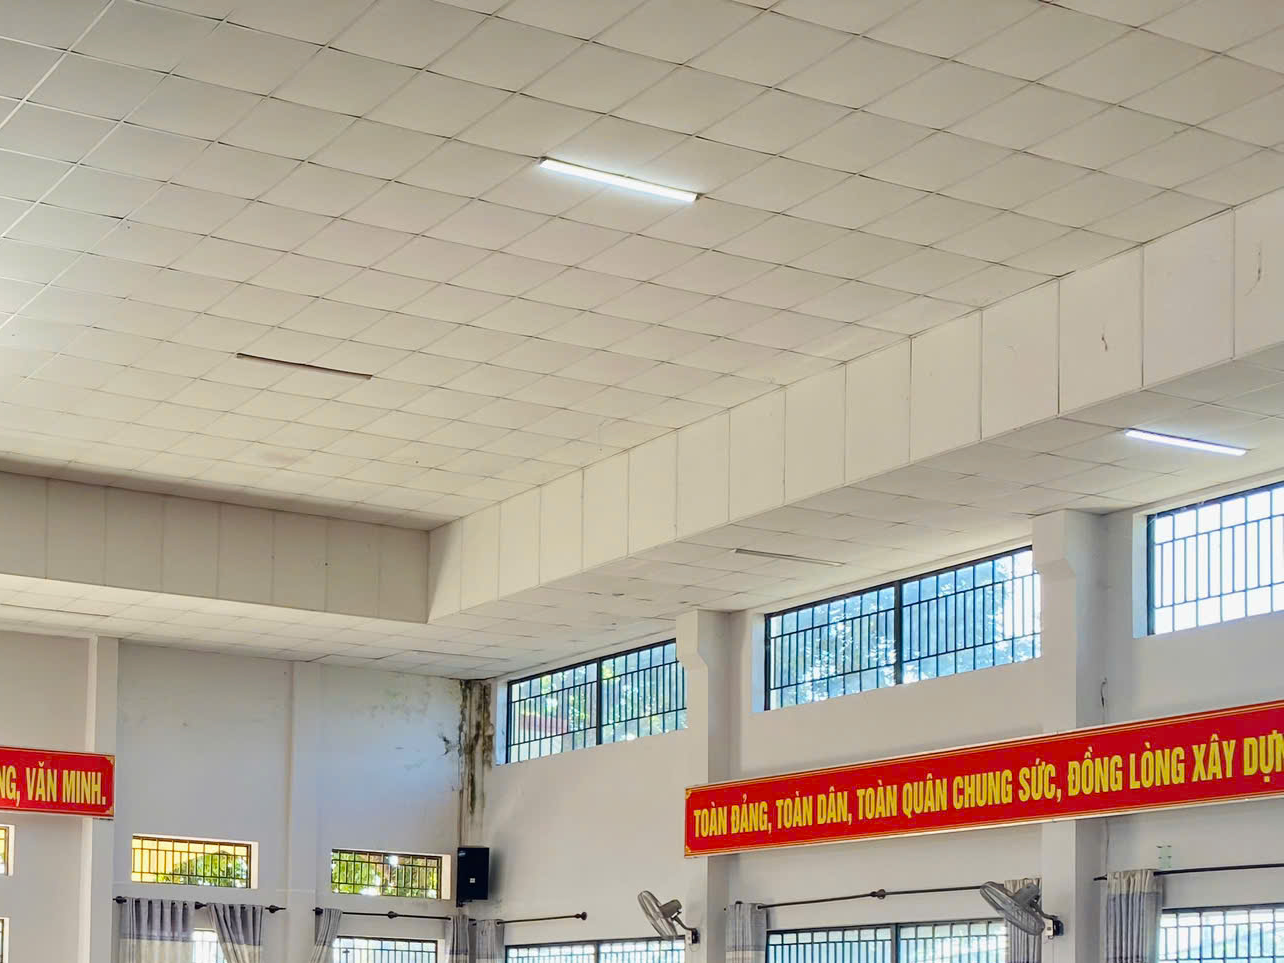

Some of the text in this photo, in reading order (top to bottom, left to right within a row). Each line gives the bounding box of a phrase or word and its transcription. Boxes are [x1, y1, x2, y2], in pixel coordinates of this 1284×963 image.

[25, 761, 58, 802] VĂN
[62, 769, 107, 805] MINH.
[693, 801, 728, 838] TOÀN
[730, 794, 772, 834] ĐẢNG,
[775, 790, 813, 829] TOÀN
[817, 785, 853, 825] DÂN,
[856, 779, 898, 821] TOÀN
[902, 773, 948, 819] QUÂN
[952, 769, 1013, 810] CHUNG
[1018, 758, 1062, 803] SỨC,
[1067, 746, 1123, 797] ĐỒNG
[1129, 741, 1185, 790] LÒNG
[1191, 733, 1237, 782] XÂY
